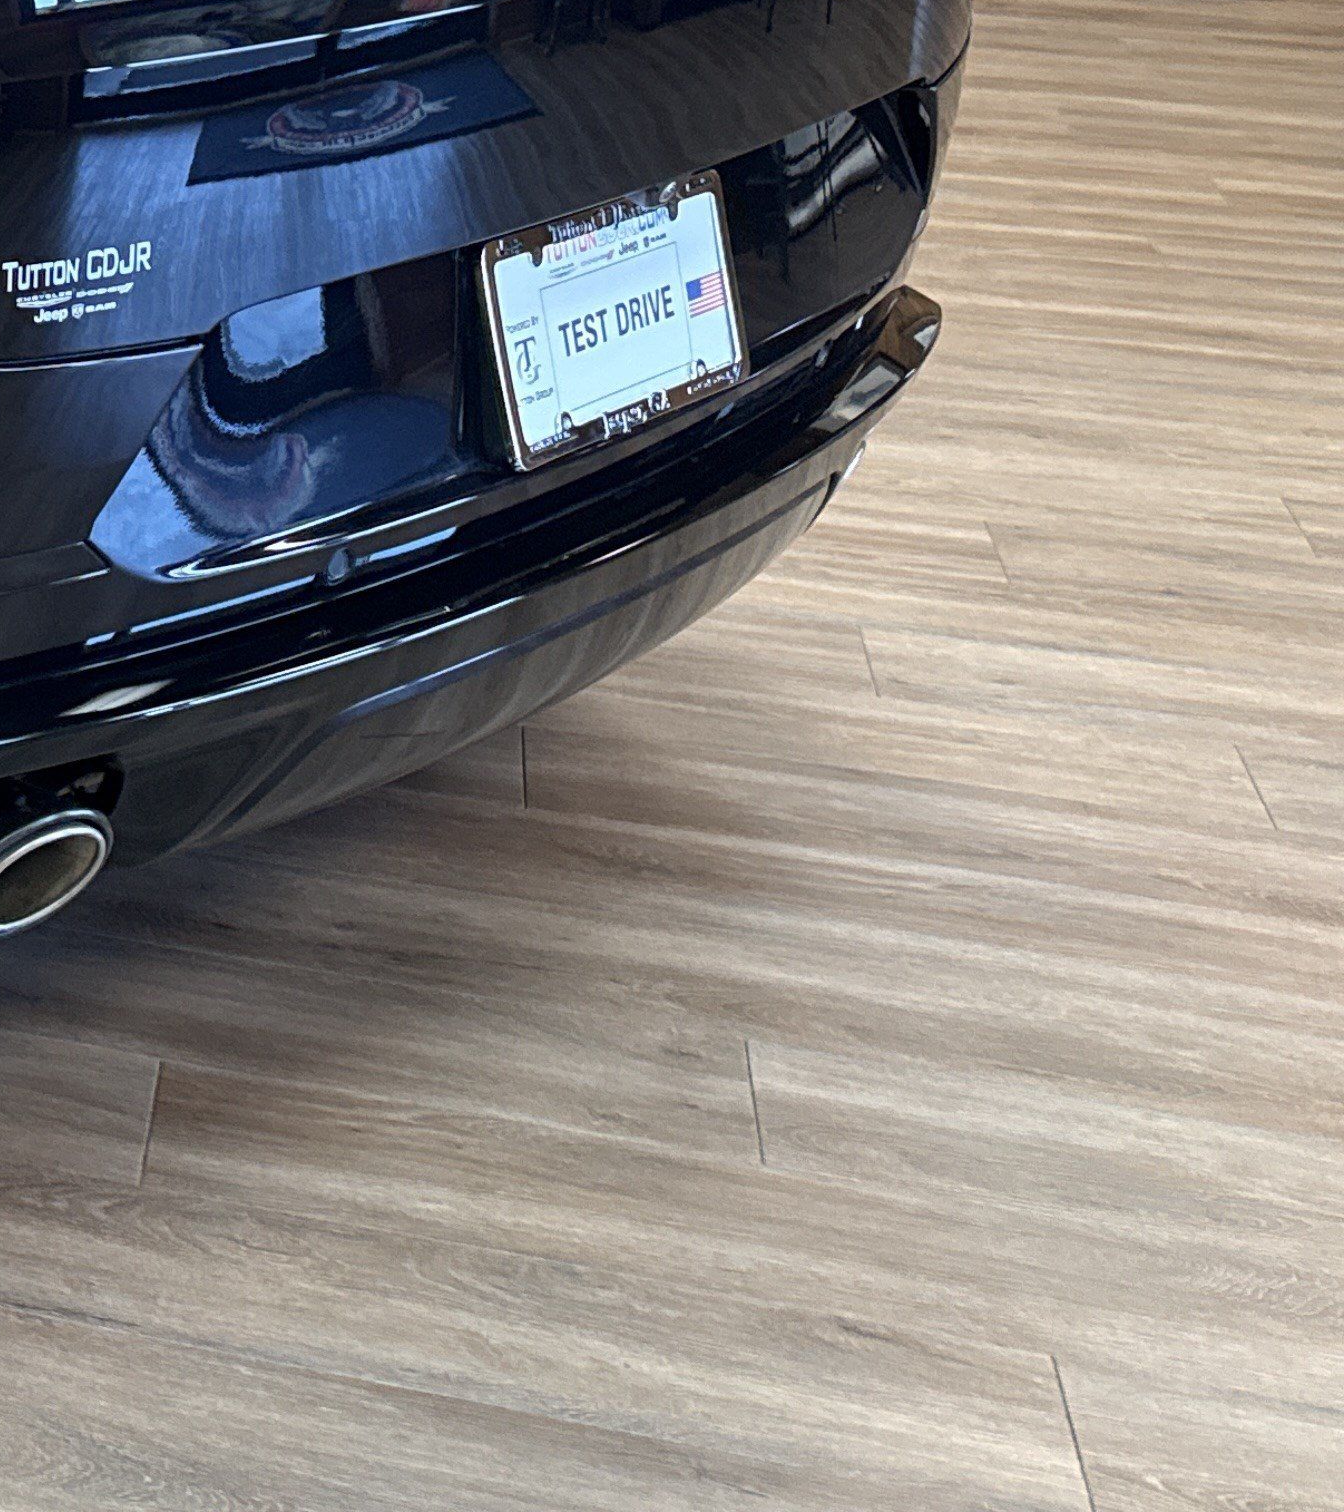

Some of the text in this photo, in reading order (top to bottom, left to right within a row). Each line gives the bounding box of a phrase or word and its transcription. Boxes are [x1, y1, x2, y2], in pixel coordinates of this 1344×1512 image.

[85, 241, 152, 281] CDJR
[33, 302, 117, 324] Jeep RAM
[558, 285, 676, 357] TEST DRIVE
